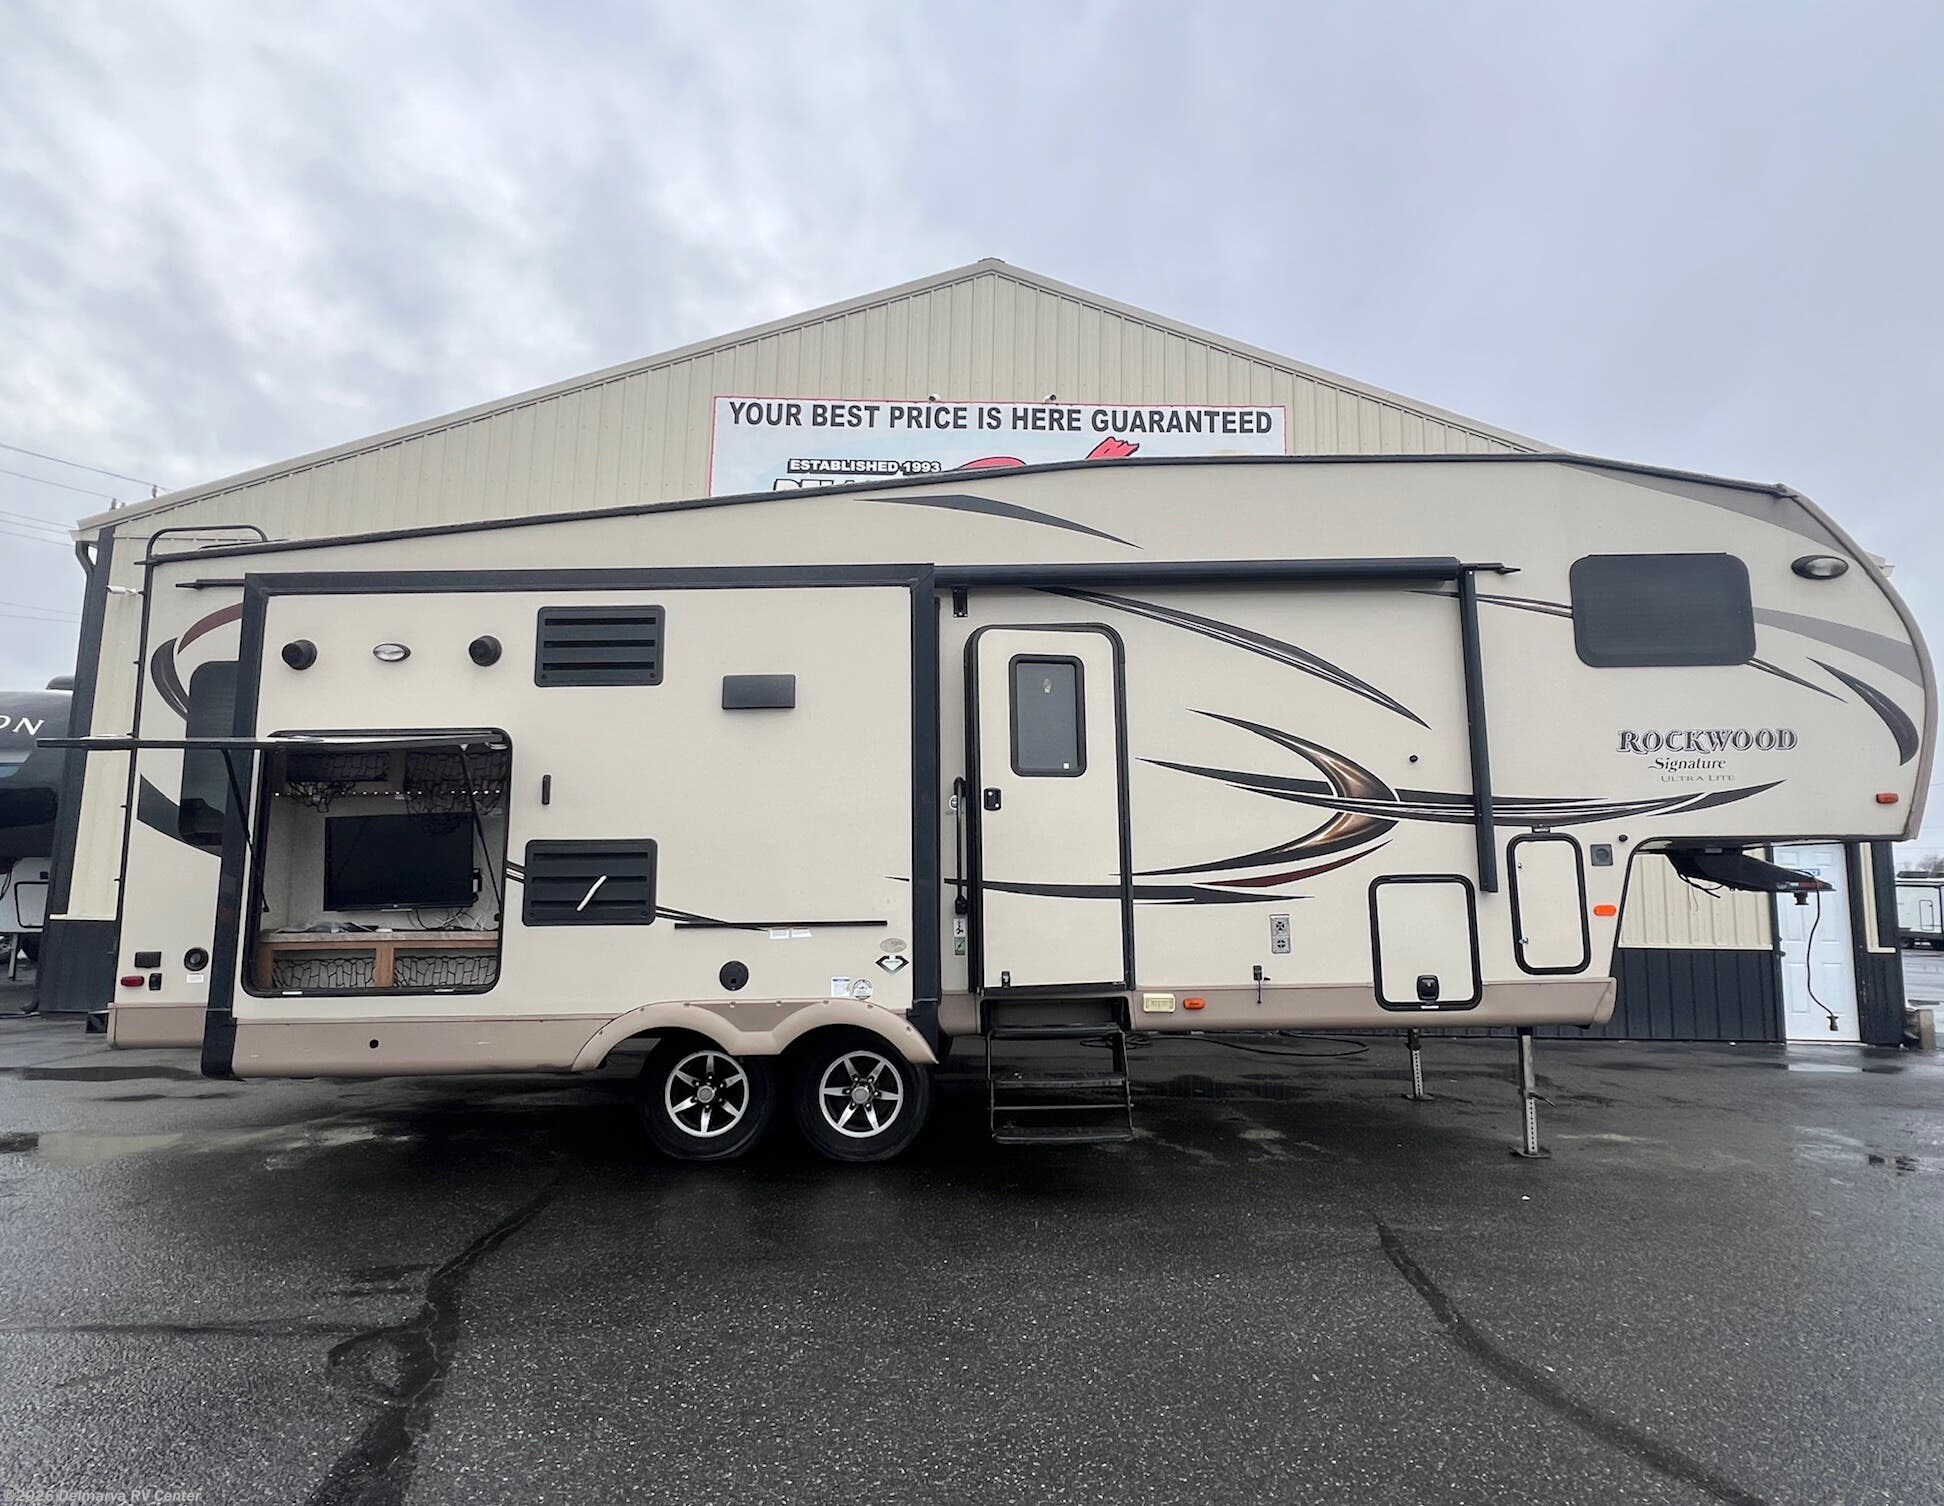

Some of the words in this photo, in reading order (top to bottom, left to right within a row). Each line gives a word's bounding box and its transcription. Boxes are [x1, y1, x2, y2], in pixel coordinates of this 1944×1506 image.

[729, 401, 802, 427] YOUR
[811, 404, 880, 429] BEST
[889, 406, 968, 430] PRICE
[977, 407, 1002, 430] IS
[1011, 407, 1082, 432] HERE
[1091, 408, 1272, 434] GUARANTEED
[788, 459, 899, 474] ESTABLISHED
[902, 460, 941, 474] 1993
[1616, 728, 1798, 755] ROCKWOOD
[1648, 757, 1727, 773] Signature
